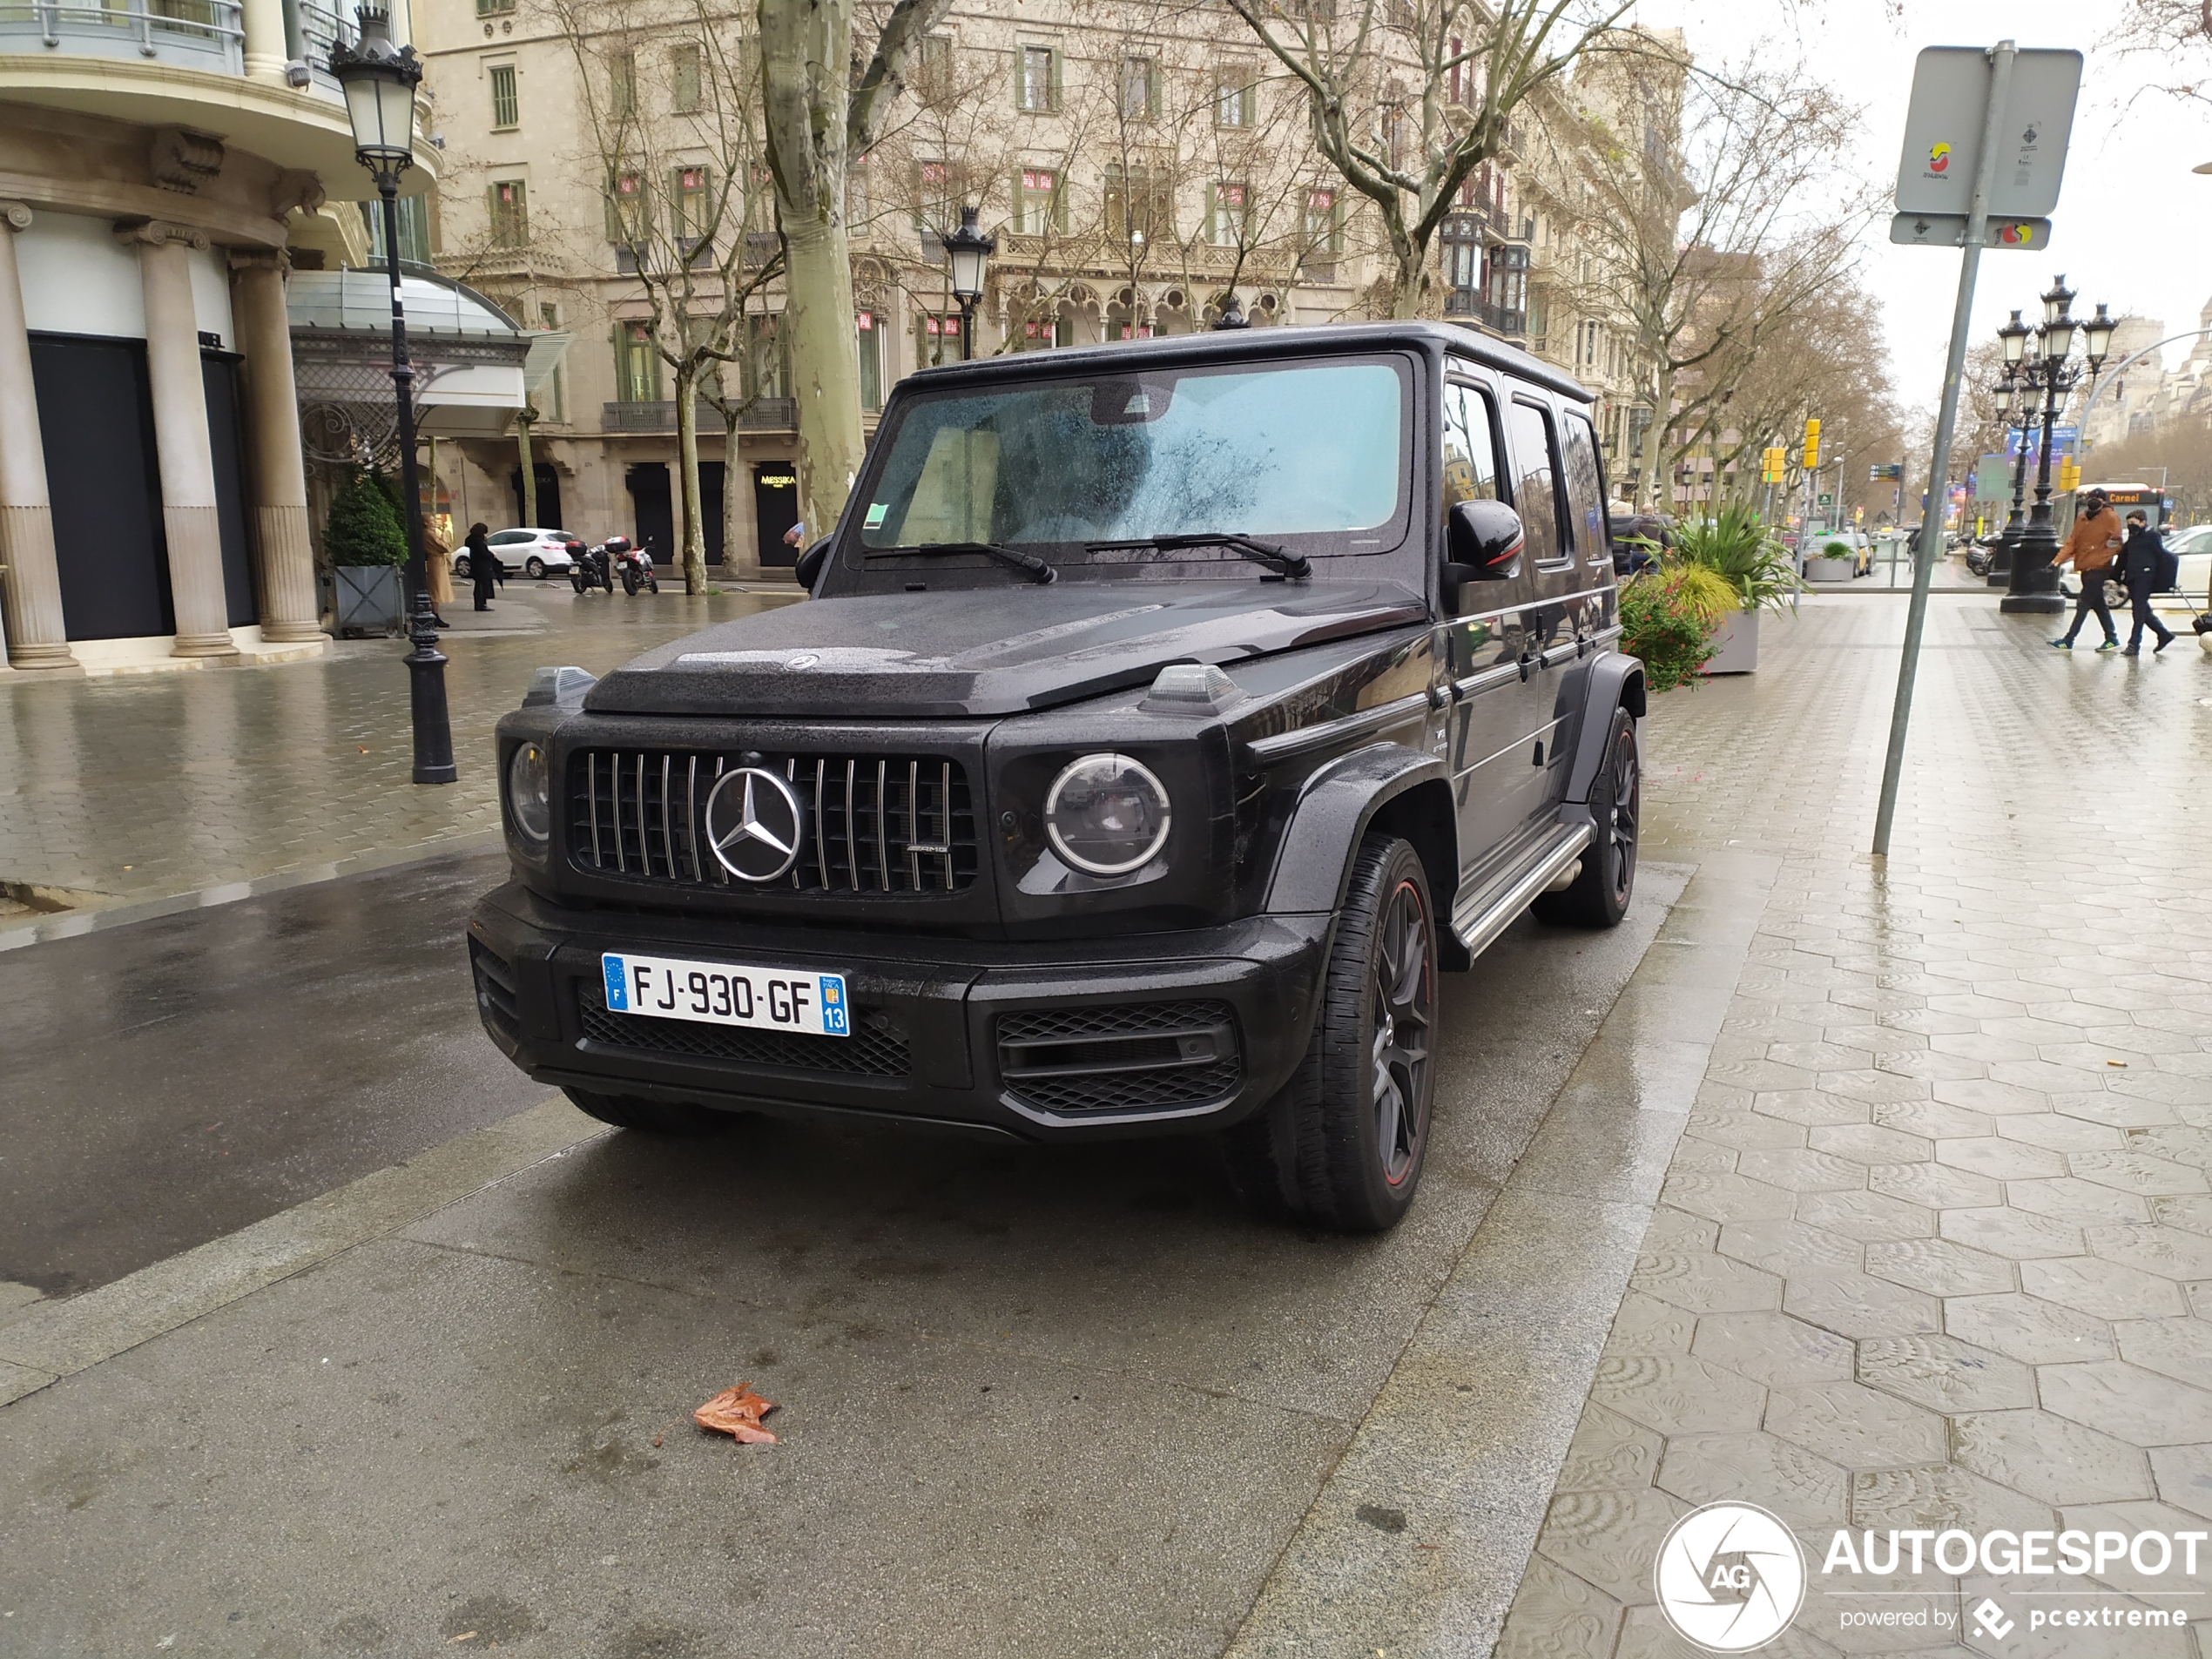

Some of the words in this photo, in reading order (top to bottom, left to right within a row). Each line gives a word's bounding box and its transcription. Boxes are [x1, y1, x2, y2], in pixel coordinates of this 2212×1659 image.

[198, 330, 225, 348] NEL
[760, 475, 796, 485] MESSIKA
[2109, 493, 2140, 502] Carmel
[613, 988, 620, 1001] F
[633, 966, 811, 1024] FJ-930-GF
[825, 1007, 845, 1028] 13
